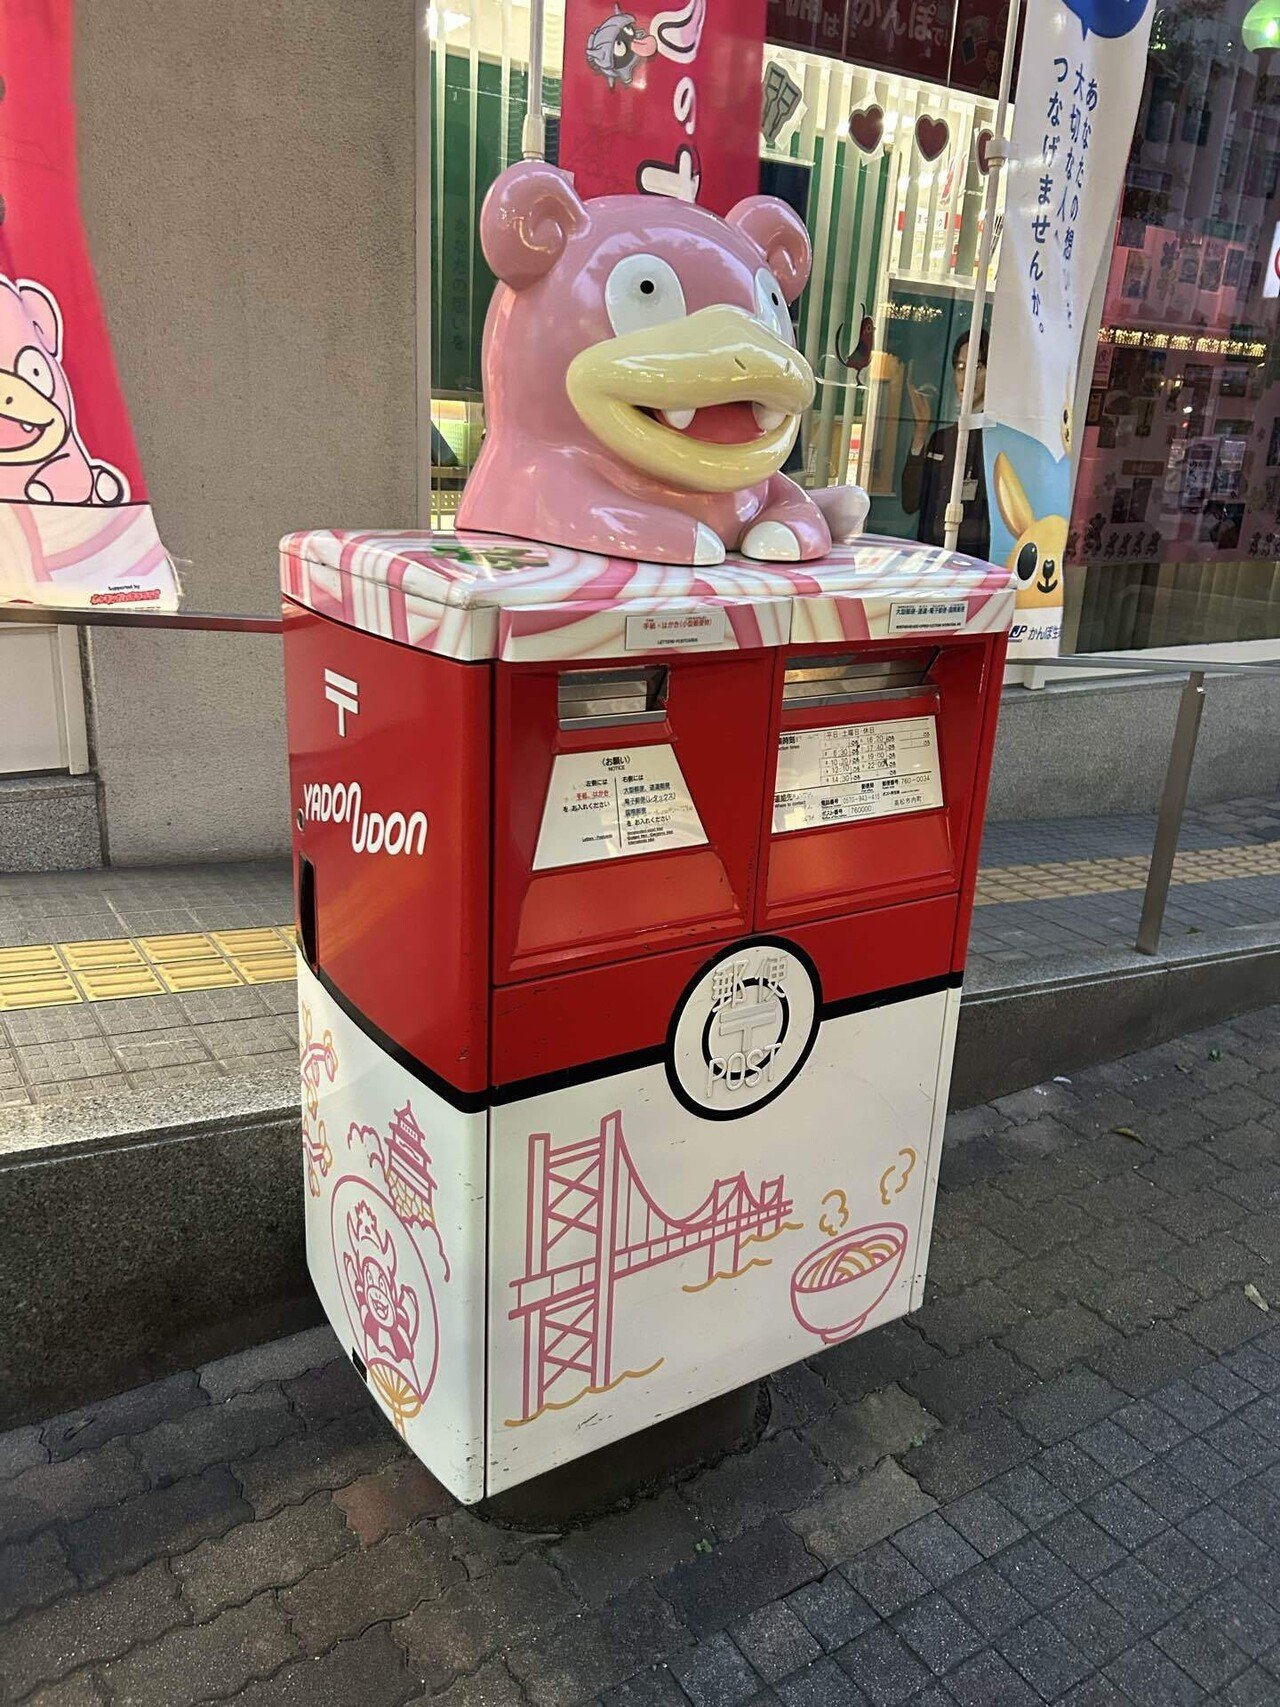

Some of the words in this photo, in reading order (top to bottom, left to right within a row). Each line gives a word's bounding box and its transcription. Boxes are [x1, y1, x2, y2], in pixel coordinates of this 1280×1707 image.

[304, 782, 362, 824] YADON
[352, 812, 428, 855] UDON
[711, 958, 787, 1013] 郵便
[707, 1042, 782, 1099] POST
